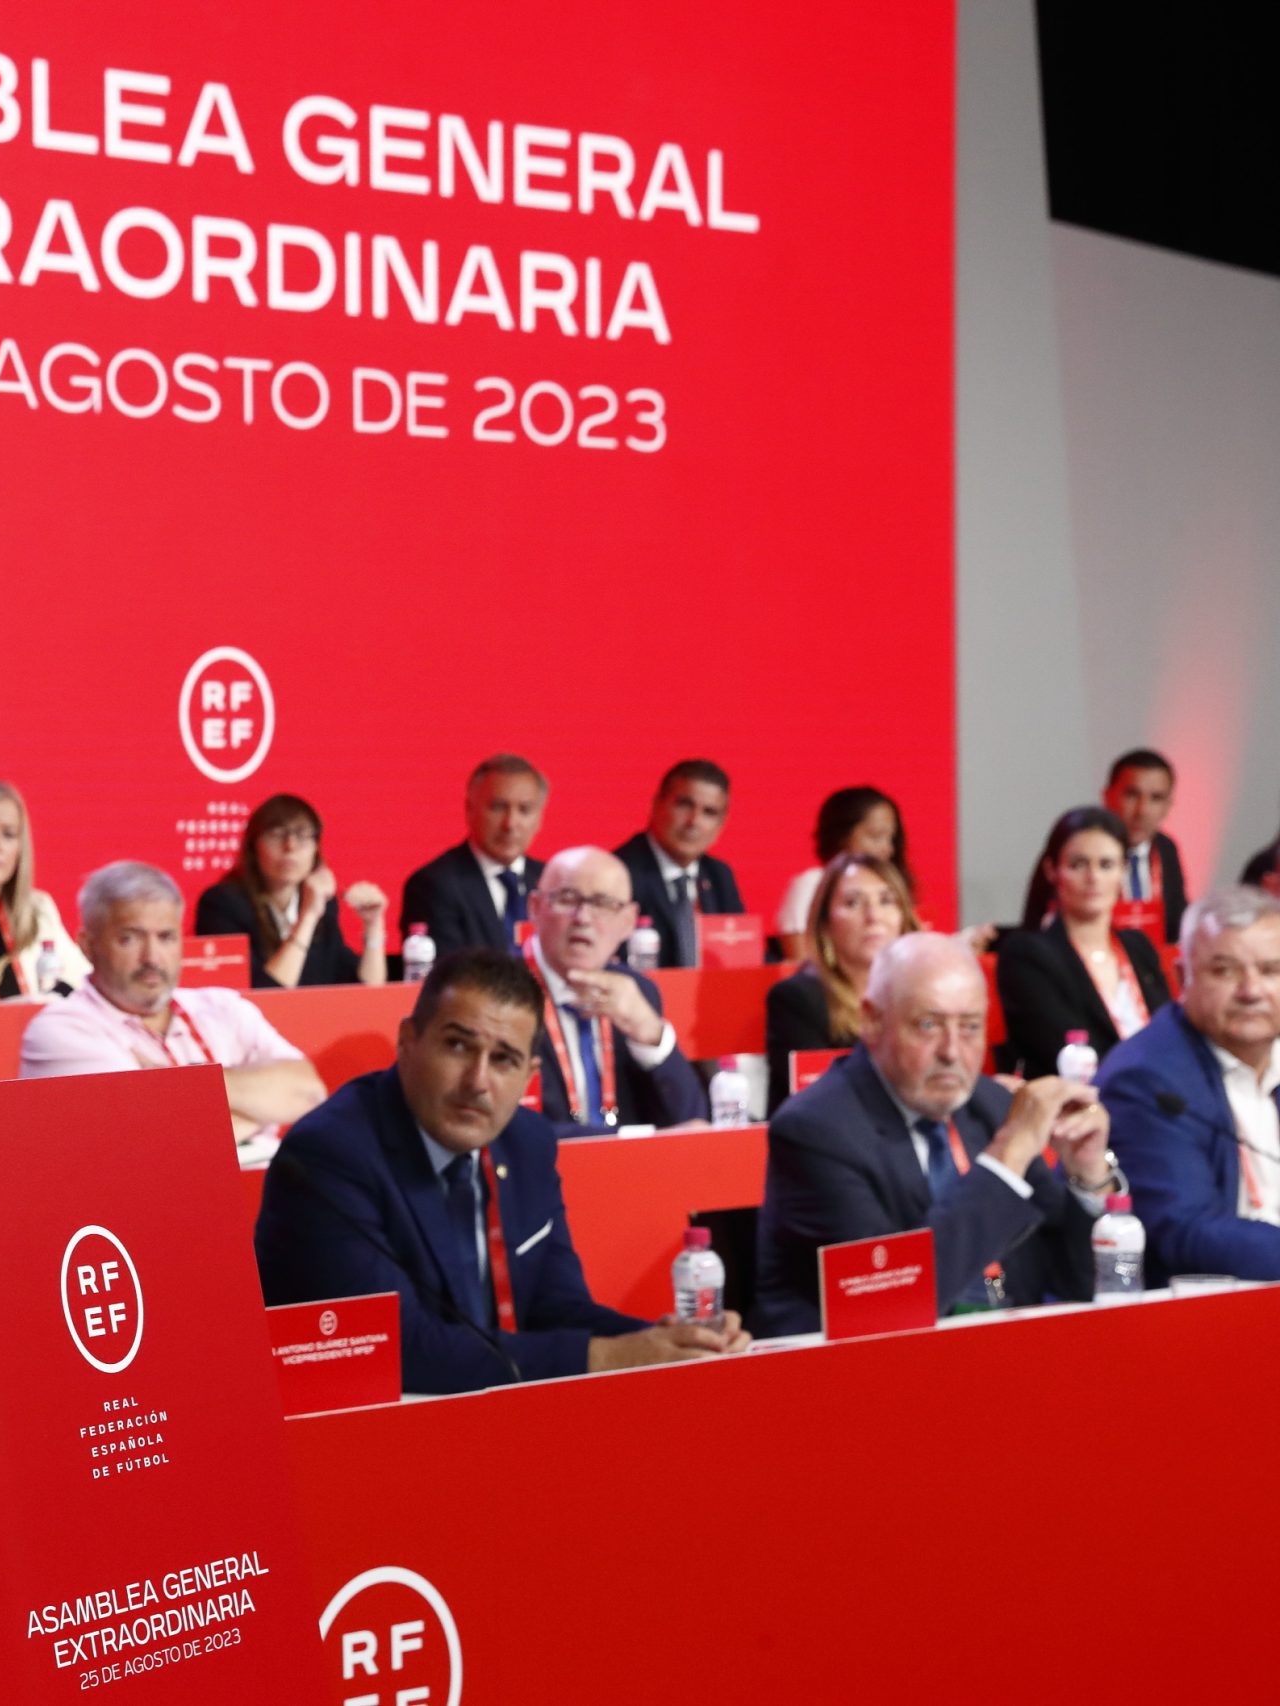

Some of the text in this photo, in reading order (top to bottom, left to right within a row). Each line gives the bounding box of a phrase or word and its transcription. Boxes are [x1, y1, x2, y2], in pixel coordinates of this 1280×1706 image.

[282, 95, 760, 233] GENERAL
[352, 367, 449, 438] DE
[472, 377, 667, 453] 2023
[201, 680, 253, 711] RF
[201, 718, 253, 749] EF
[77, 1261, 119, 1295] RF
[84, 1302, 127, 1338] EF
[103, 1396, 139, 1412] REAL
[79, 1410, 168, 1438] FEDERACIÓN
[91, 1433, 164, 1458] ESPAÑOLA
[92, 1453, 169, 1479] DE FÚTBOL
[27, 1551, 269, 1639] ASAMBLEA GENERAL
[53, 1588, 256, 1669] EXTRAORDINARIA
[79, 1628, 241, 1690] 25 DE AGOSTO DE 2023
[342, 1619, 425, 1680] RF
